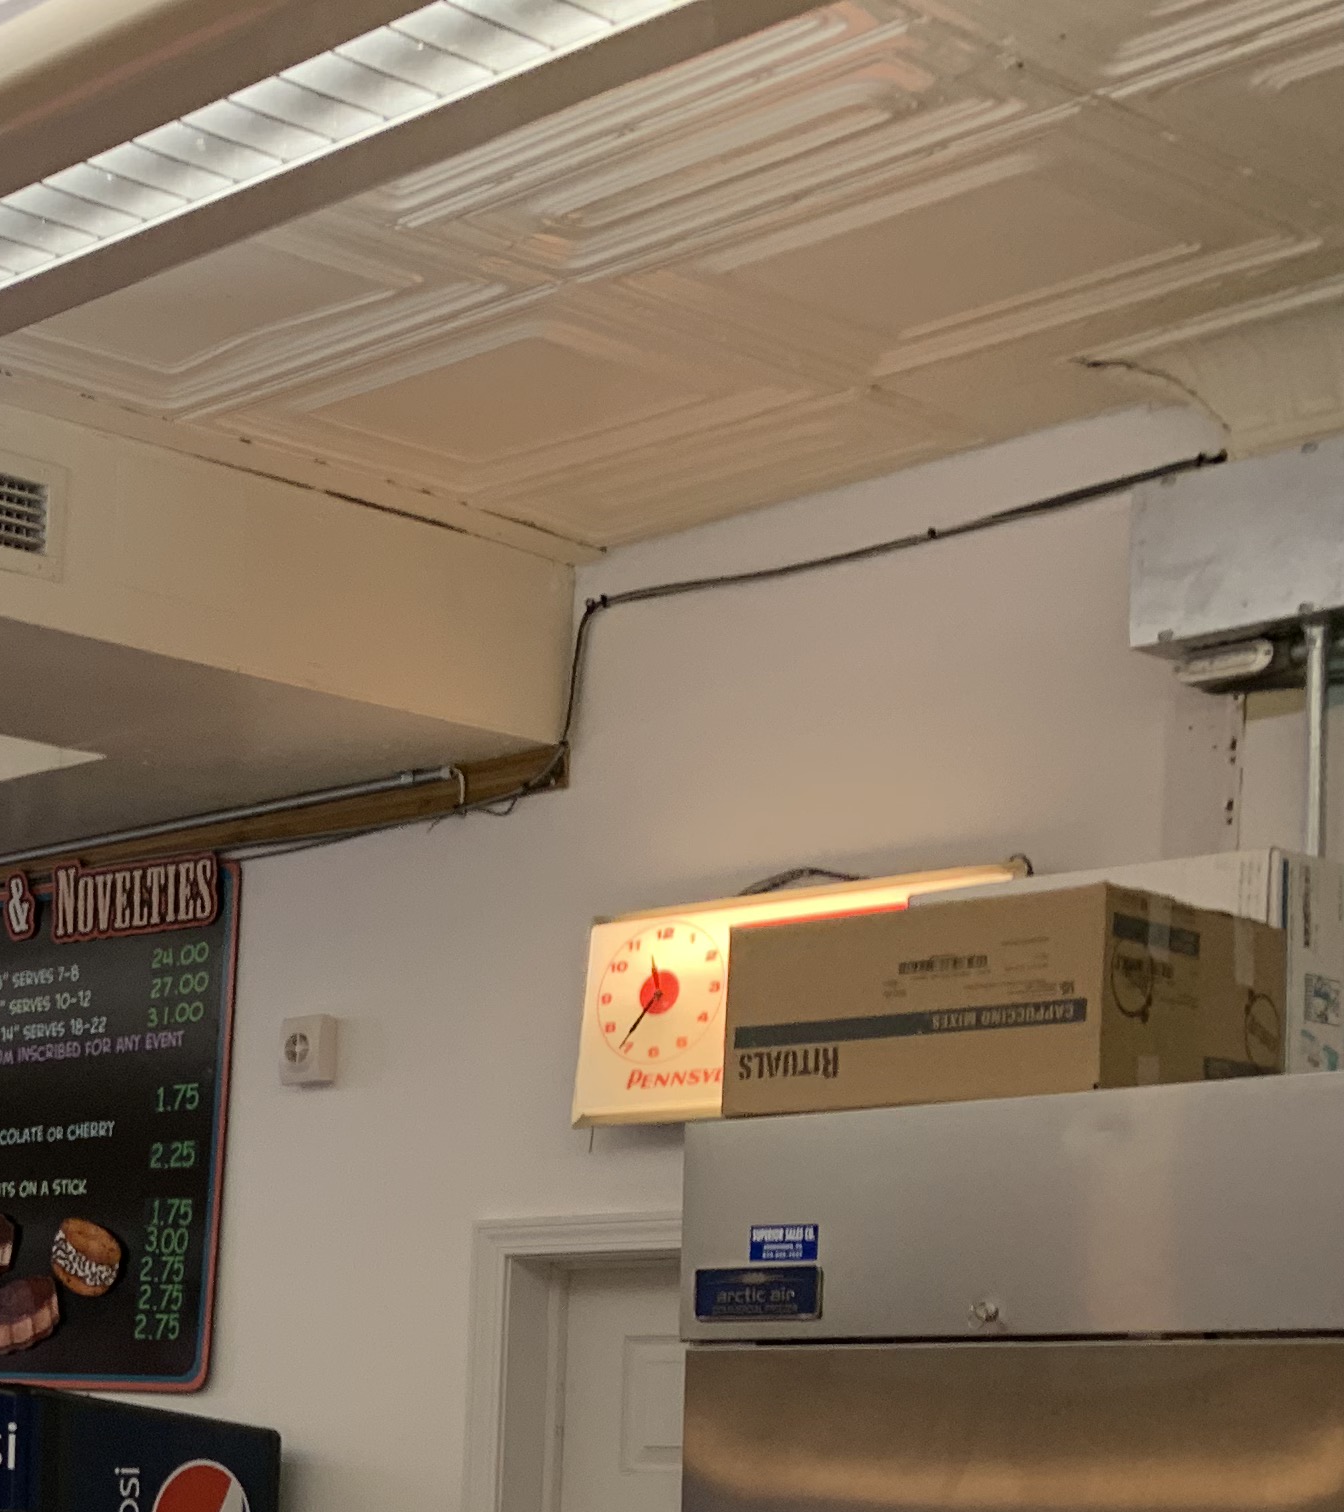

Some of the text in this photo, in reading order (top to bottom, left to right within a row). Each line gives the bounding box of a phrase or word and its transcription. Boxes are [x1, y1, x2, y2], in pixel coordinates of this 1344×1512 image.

[9, 877, 29, 933] &
[57, 859, 212, 936] NOVELTIES
[628, 939, 641, 952] 11
[657, 928, 675, 940] 12
[152, 942, 209, 969] 24.00
[611, 961, 628, 972] 10
[13, 968, 54, 988] SERVES
[58, 964, 79, 982] 7-8
[150, 972, 209, 999] 27.00
[709, 981, 720, 993] 3
[10, 996, 50, 1015] SERVES
[56, 990, 91, 1010] 10-12
[147, 1002, 204, 1027] 31.00
[980, 1003, 1075, 1026] CAPPUCCINO
[23, 1021, 65, 1040] SERVES
[71, 1017, 107, 1036] 18-22
[697, 1012, 708, 1022] 4
[18, 1042, 81, 1062] INSCRIBED
[85, 1038, 111, 1056] FOR
[116, 1034, 141, 1053] ANY
[146, 1031, 185, 1049] EVENT
[738, 1047, 839, 1081] RITUALS
[156, 1083, 199, 1113] 1.75
[47, 1126, 63, 1142] OR
[67, 1121, 115, 1140] CHERRY
[150, 1141, 195, 1169] 2.25
[153, 1199, 192, 1226] 1.75
[145, 1227, 189, 1253] 3.00
[140, 1256, 184, 1282] 2.75
[139, 1285, 182, 1310] 2.75
[716, 1286, 795, 1304] arctic air
[134, 1314, 179, 1340] 2.75
